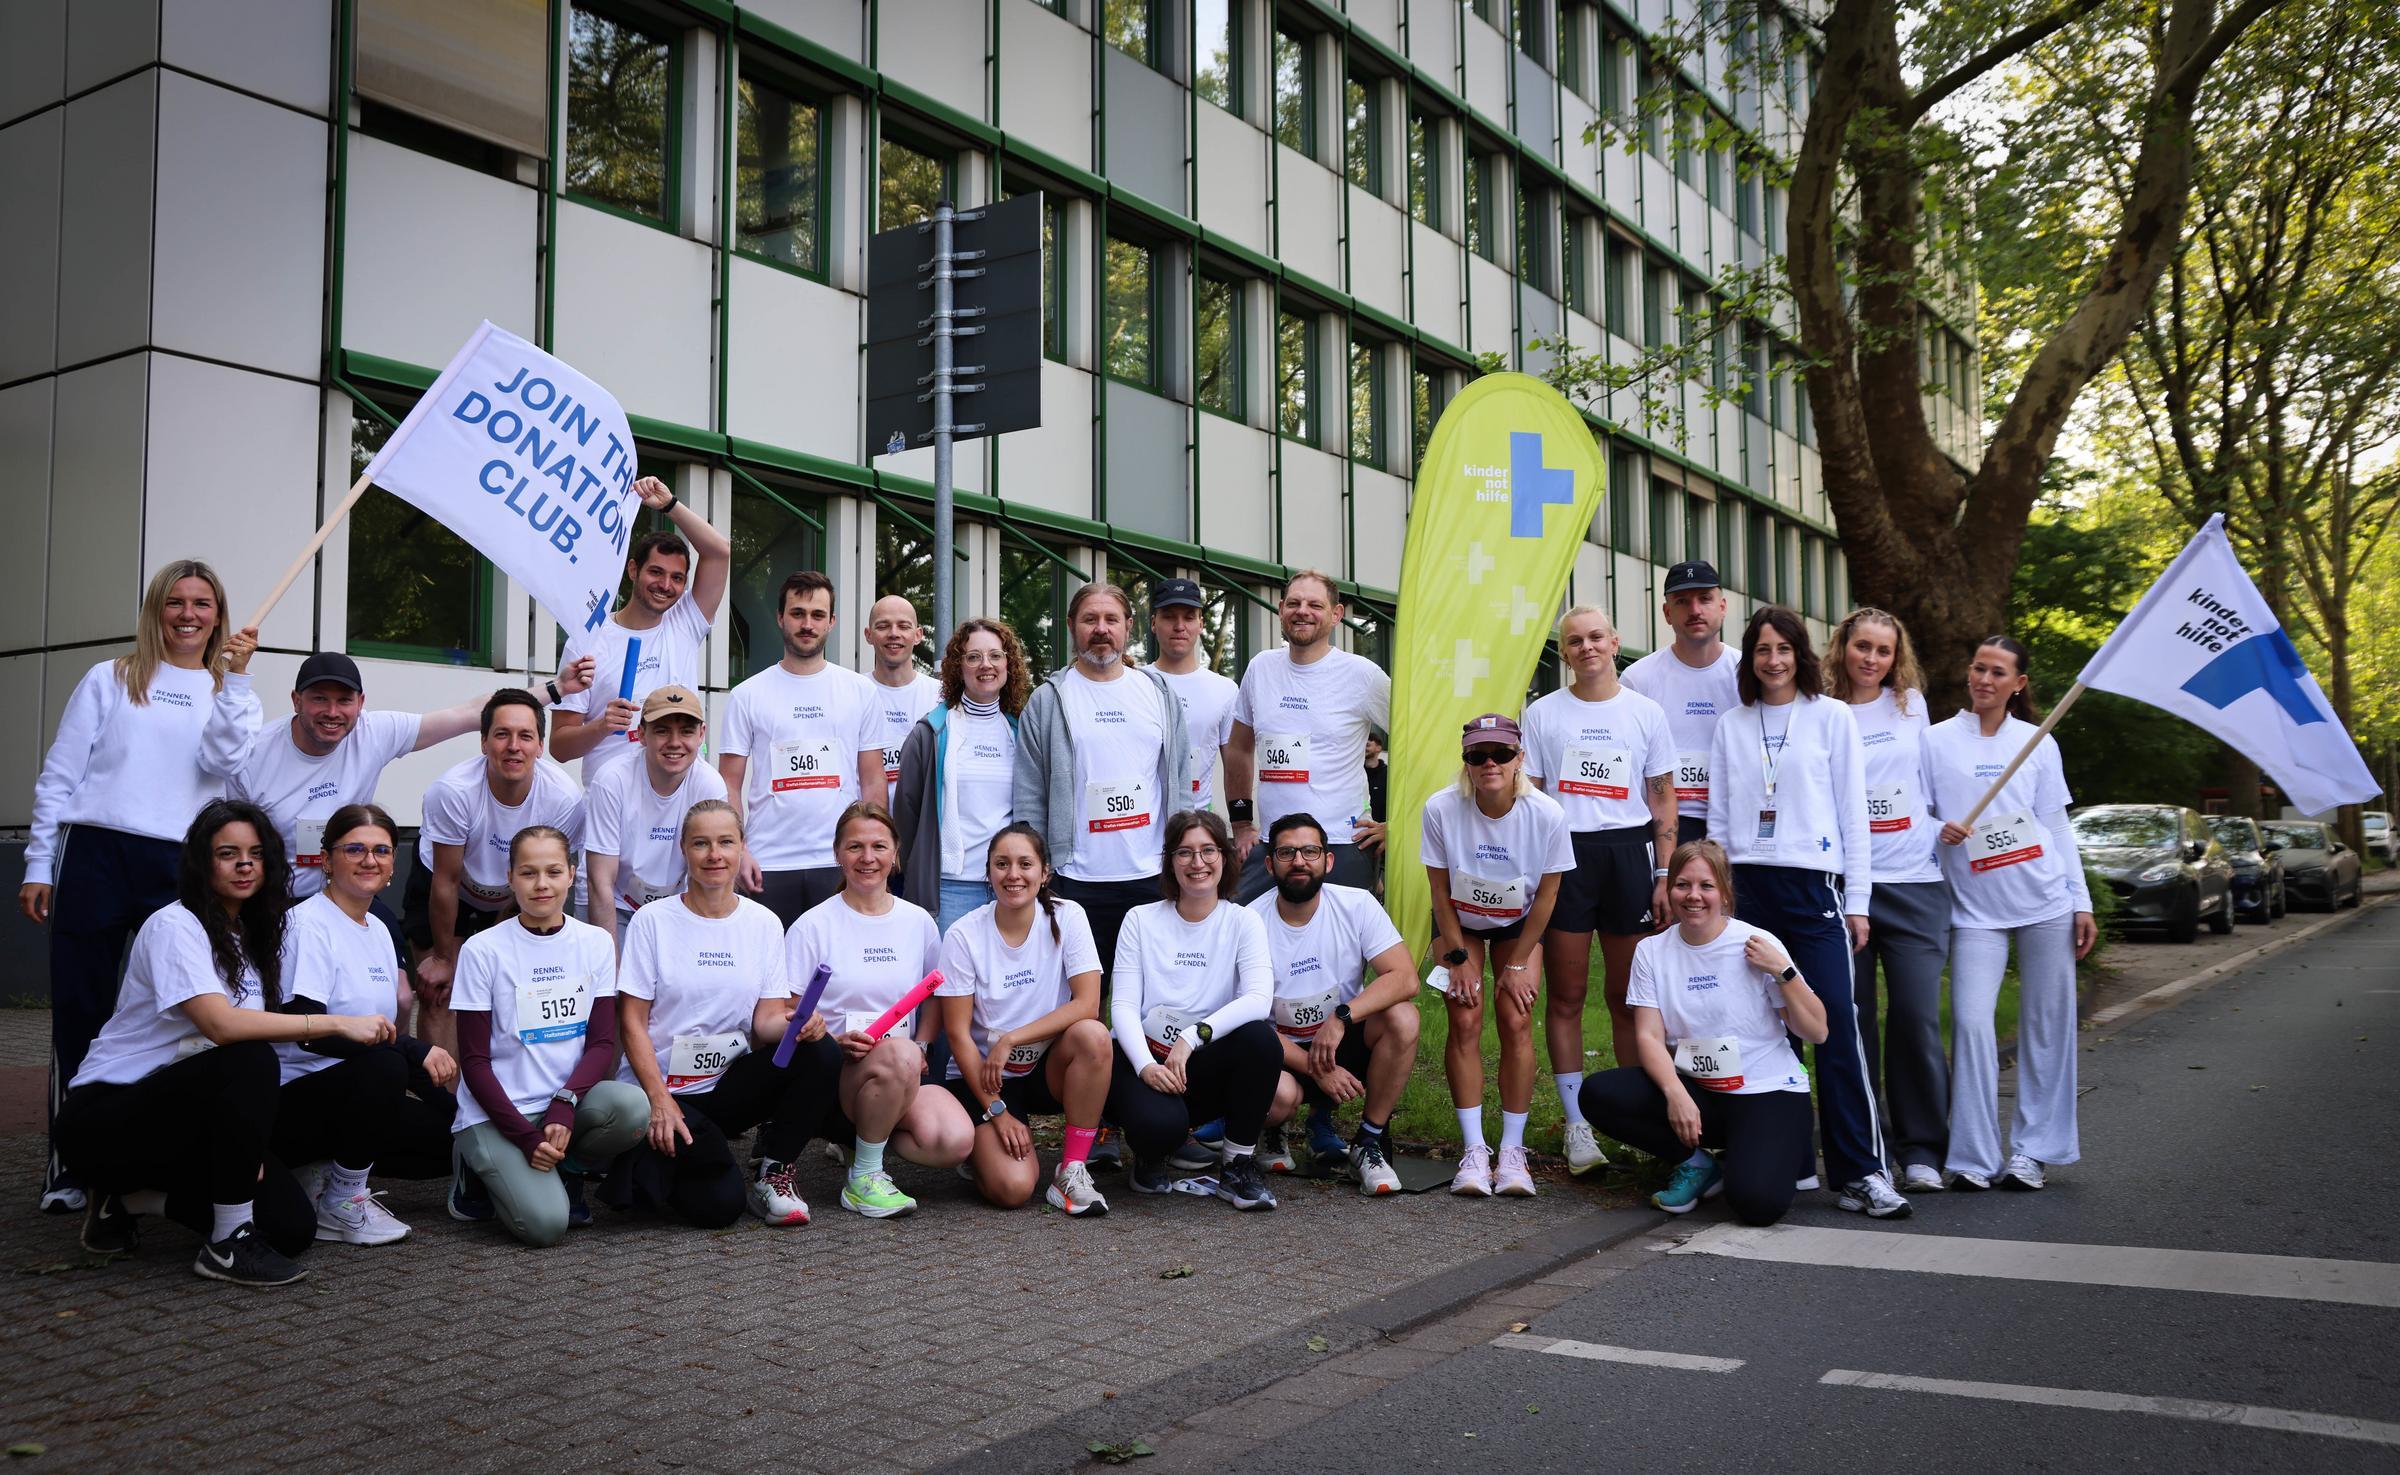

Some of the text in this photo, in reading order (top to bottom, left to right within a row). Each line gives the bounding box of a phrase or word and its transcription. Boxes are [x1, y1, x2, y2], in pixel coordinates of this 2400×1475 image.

[494, 367, 601, 448] JOIN
[453, 390, 627, 556] DONATION
[1463, 464, 1508, 477] kinder
[1485, 478, 1508, 489] not
[1476, 489, 1508, 502] hilfe
[479, 459, 583, 564] CLUB.
[2187, 587, 2254, 633] kinder
[2175, 621, 2223, 653] hilfe
[2201, 617, 2240, 642] not
[152, 695, 194, 707] SPENDEN.
[156, 689, 193, 700] RENNEN.
[790, 754, 819, 772] S481
[882, 750, 900, 766] S49
[1266, 749, 1290, 765] S484
[1580, 760, 1611, 780] S562
[1681, 766, 1710, 783] S564
[1106, 795, 1135, 813] S503
[1866, 799, 1893, 815] S551
[652, 826, 677, 834] RENNE
[1985, 830, 2018, 850] S554
[1475, 852, 1511, 861] SPENDEN.
[1478, 844, 1509, 853] RENNEN.
[1472, 888, 1503, 905] S563
[697, 959, 736, 967] SPENDEN.
[699, 951, 734, 959] RENNEN.
[863, 955, 898, 963] SPENDEN.
[1290, 956, 1319, 969] RENNEN.
[533, 966, 566, 975] RENNEN.
[1005, 969, 1034, 981] RENNEN.
[1289, 963, 1321, 977] SPENDEN.
[1003, 977, 1036, 989] SPENDEN.
[1687, 982, 1720, 991] SPENDEN.
[1688, 974, 1718, 983] RENNEN.
[541, 997, 577, 1020] 5152
[1294, 1009, 1324, 1026] S933
[1162, 1025, 1182, 1043] S5
[693, 1051, 727, 1070] S502
[1008, 1048, 1040, 1062] S932
[1692, 1055, 1720, 1072] S504
